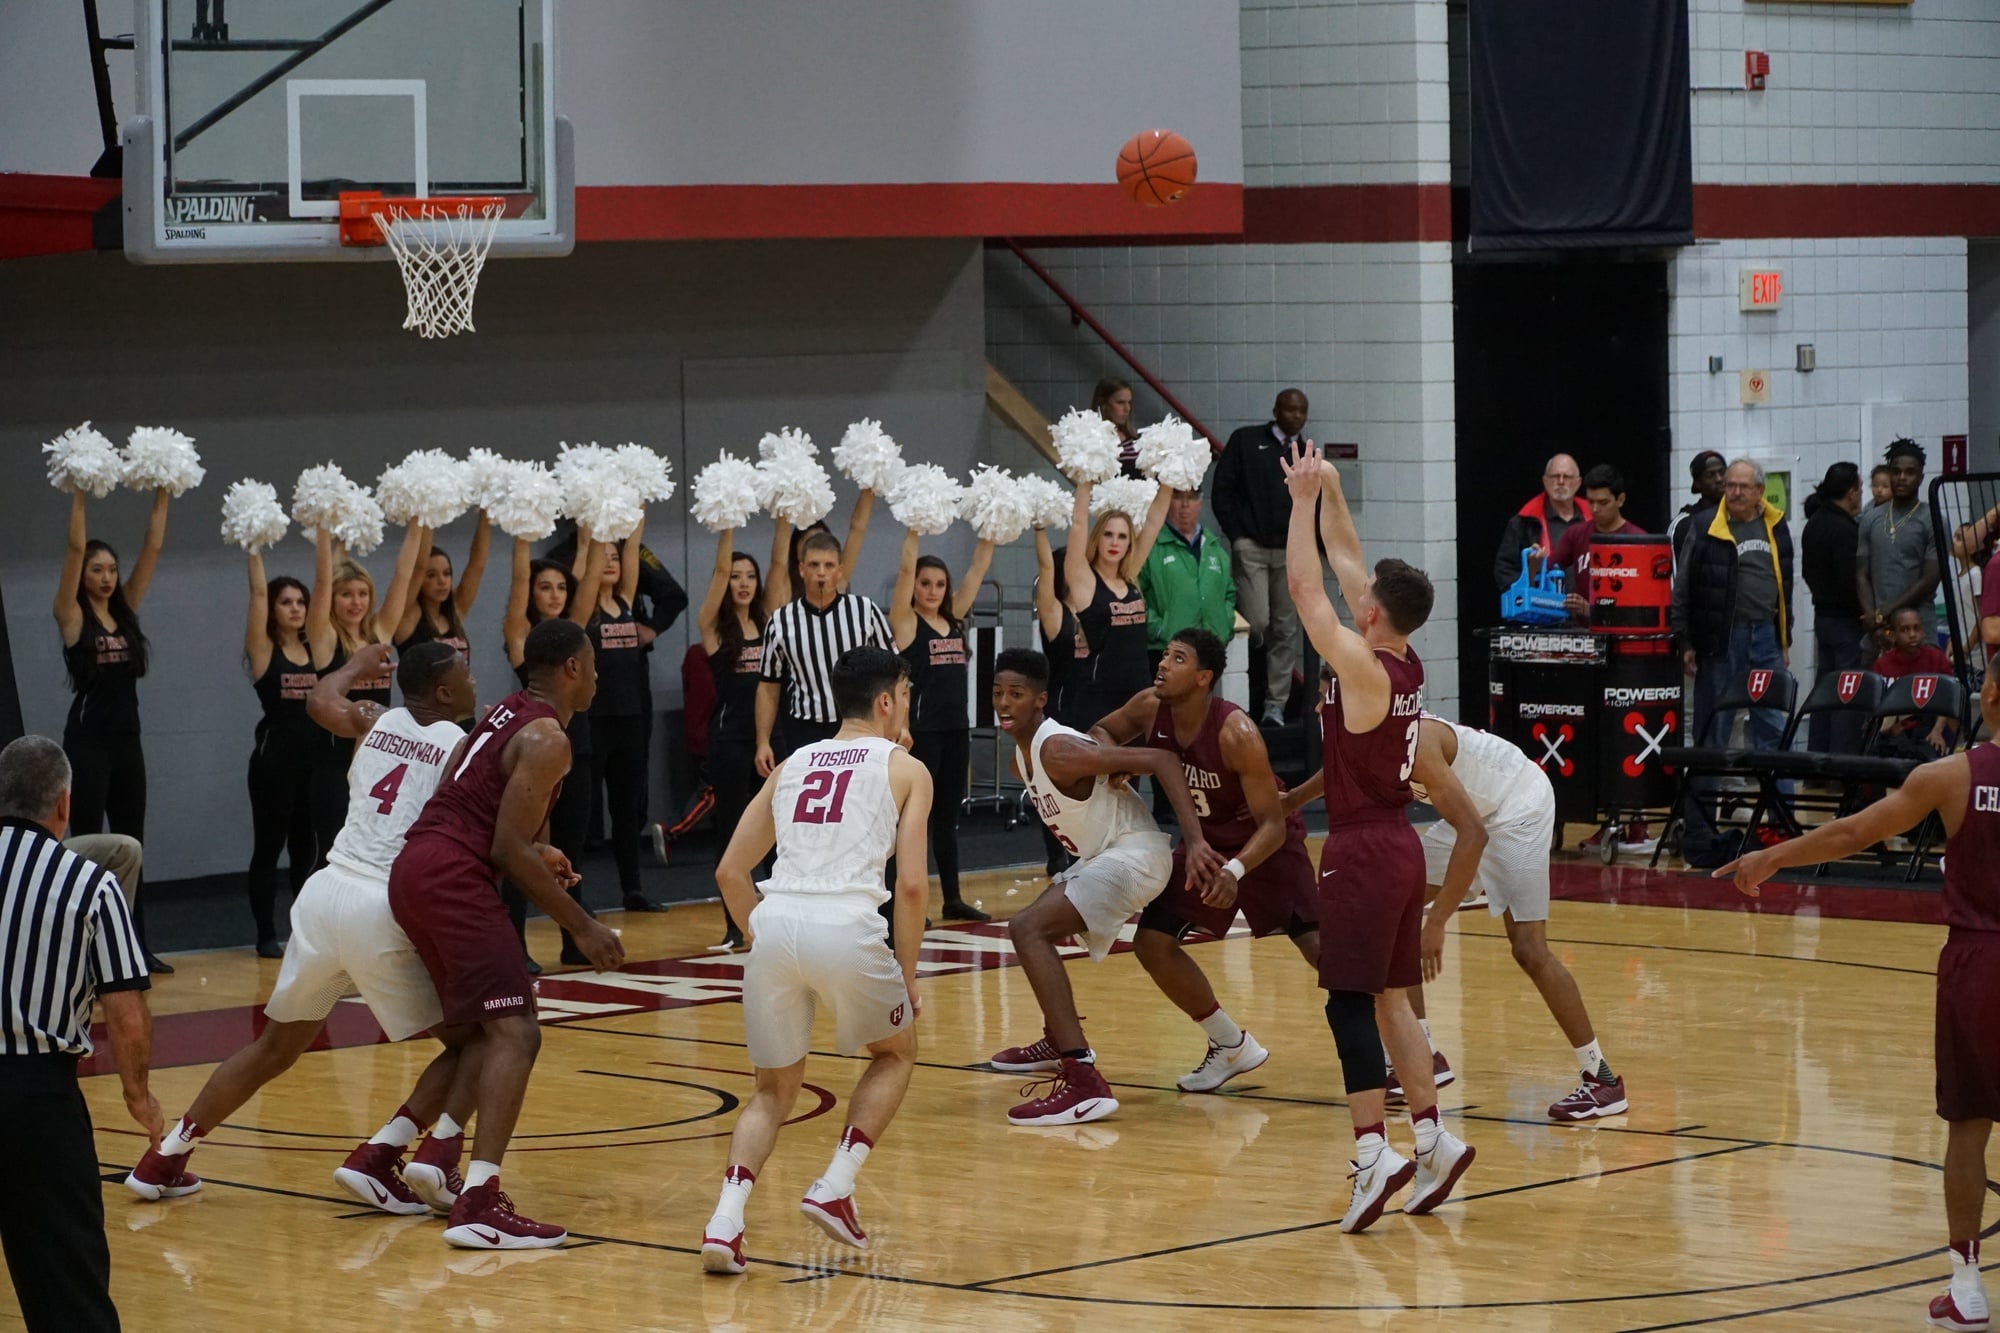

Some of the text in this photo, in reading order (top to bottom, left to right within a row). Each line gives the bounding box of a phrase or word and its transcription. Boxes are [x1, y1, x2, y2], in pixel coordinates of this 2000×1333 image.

[165, 228, 206, 240] SPALDING
[1752, 273, 1779, 304] EXIT
[1500, 636, 1595, 653] POWERADE
[1752, 672, 1767, 692] H
[1841, 674, 1857, 694] H
[1916, 676, 1931, 698] H
[1604, 686, 1680, 701] POWERADE
[1520, 703, 1585, 716] POWERADE
[365, 730, 446, 767] EDOSOMWAN
[454, 731, 493, 781] 1
[808, 749, 869, 767] YOSHOR
[1399, 719, 1419, 781] 3
[369, 763, 409, 815] 4
[792, 769, 854, 824] 21
[1975, 785, 2000, 813] CH
[1190, 789, 1211, 817] 3
[483, 996, 524, 1010] HARVARD
